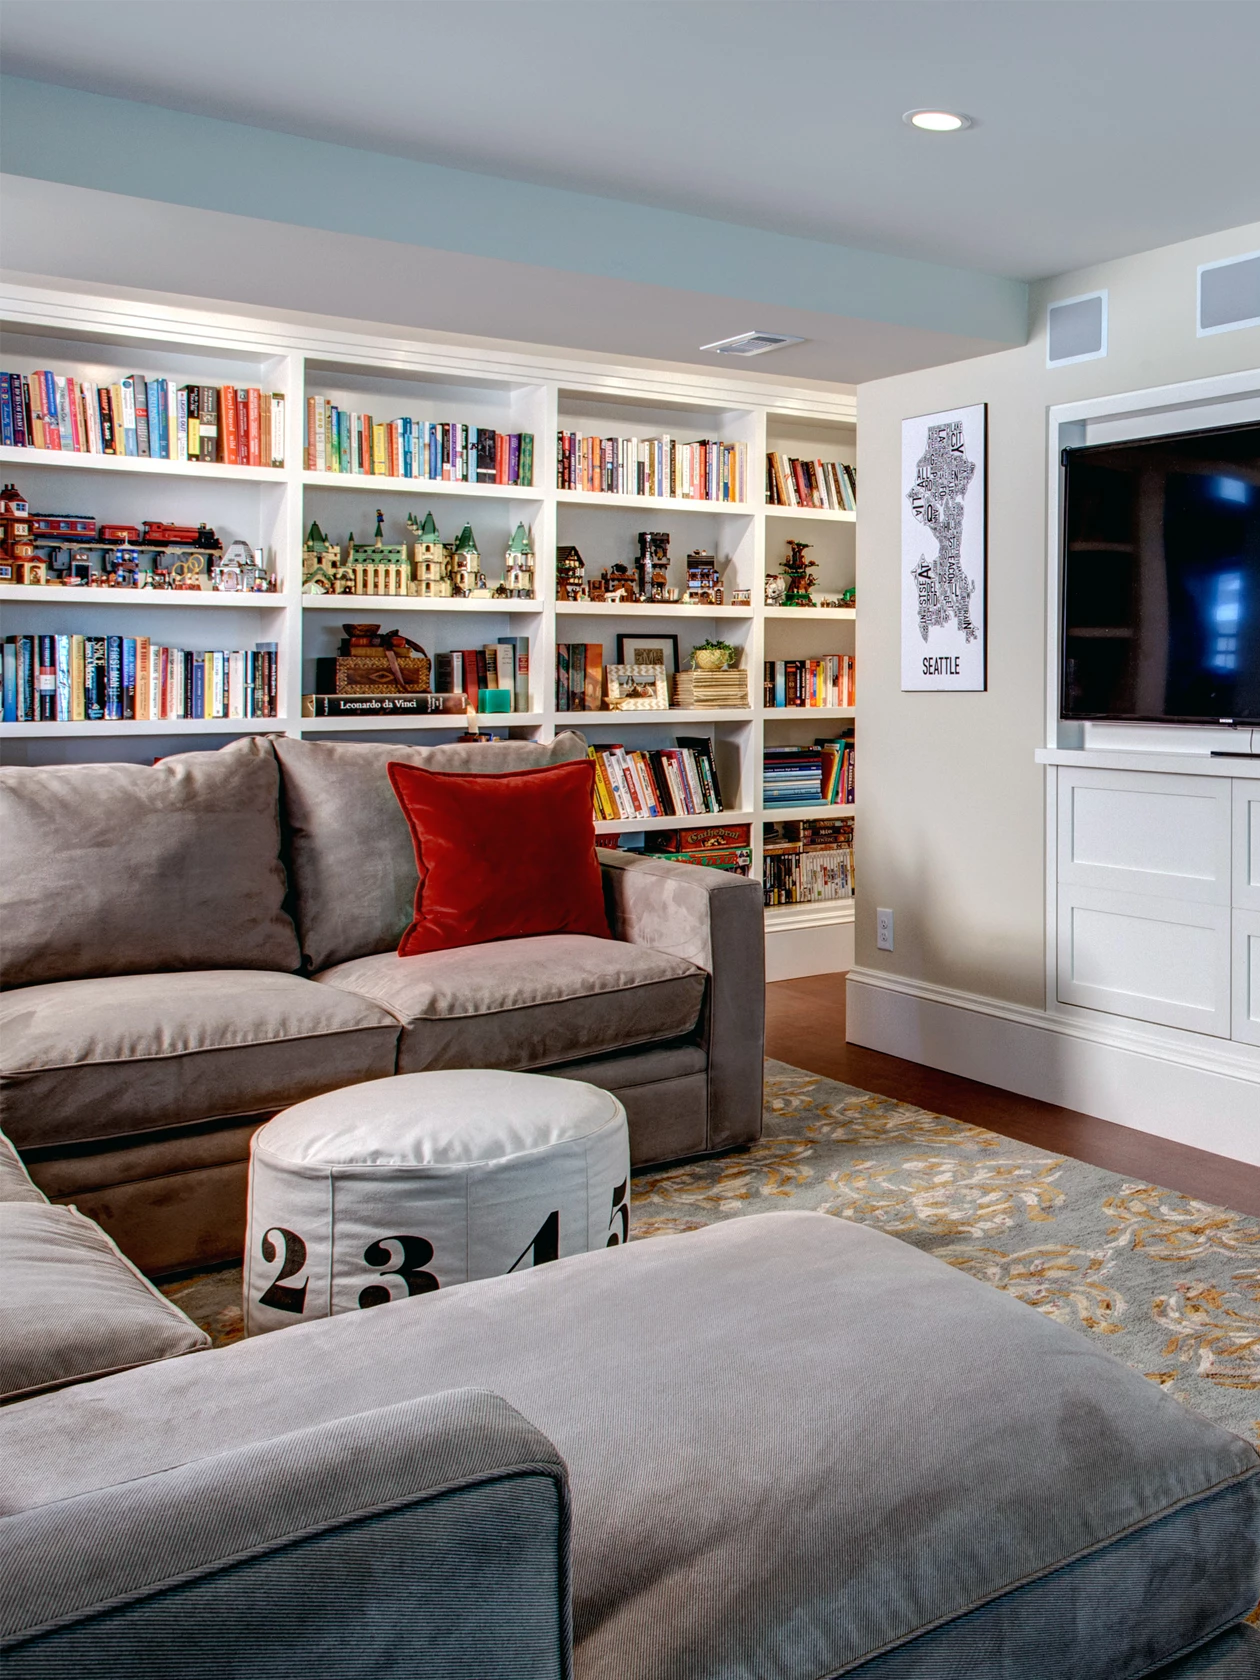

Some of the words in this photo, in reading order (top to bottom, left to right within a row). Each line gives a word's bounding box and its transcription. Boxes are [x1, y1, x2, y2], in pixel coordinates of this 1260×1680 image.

[94, 641, 105, 666] SPACE
[110, 647, 120, 668] FIRST
[922, 656, 960, 675] SEATTLE
[110, 670, 120, 687] MAN
[340, 700, 382, 709] Leonardo
[383, 700, 393, 709] da
[394, 698, 417, 708] Vinci
[687, 828, 740, 844] Cathedral
[258, 1226, 310, 1314] 2
[357, 1235, 441, 1310] 3
[606, 1175, 629, 1249] 5
